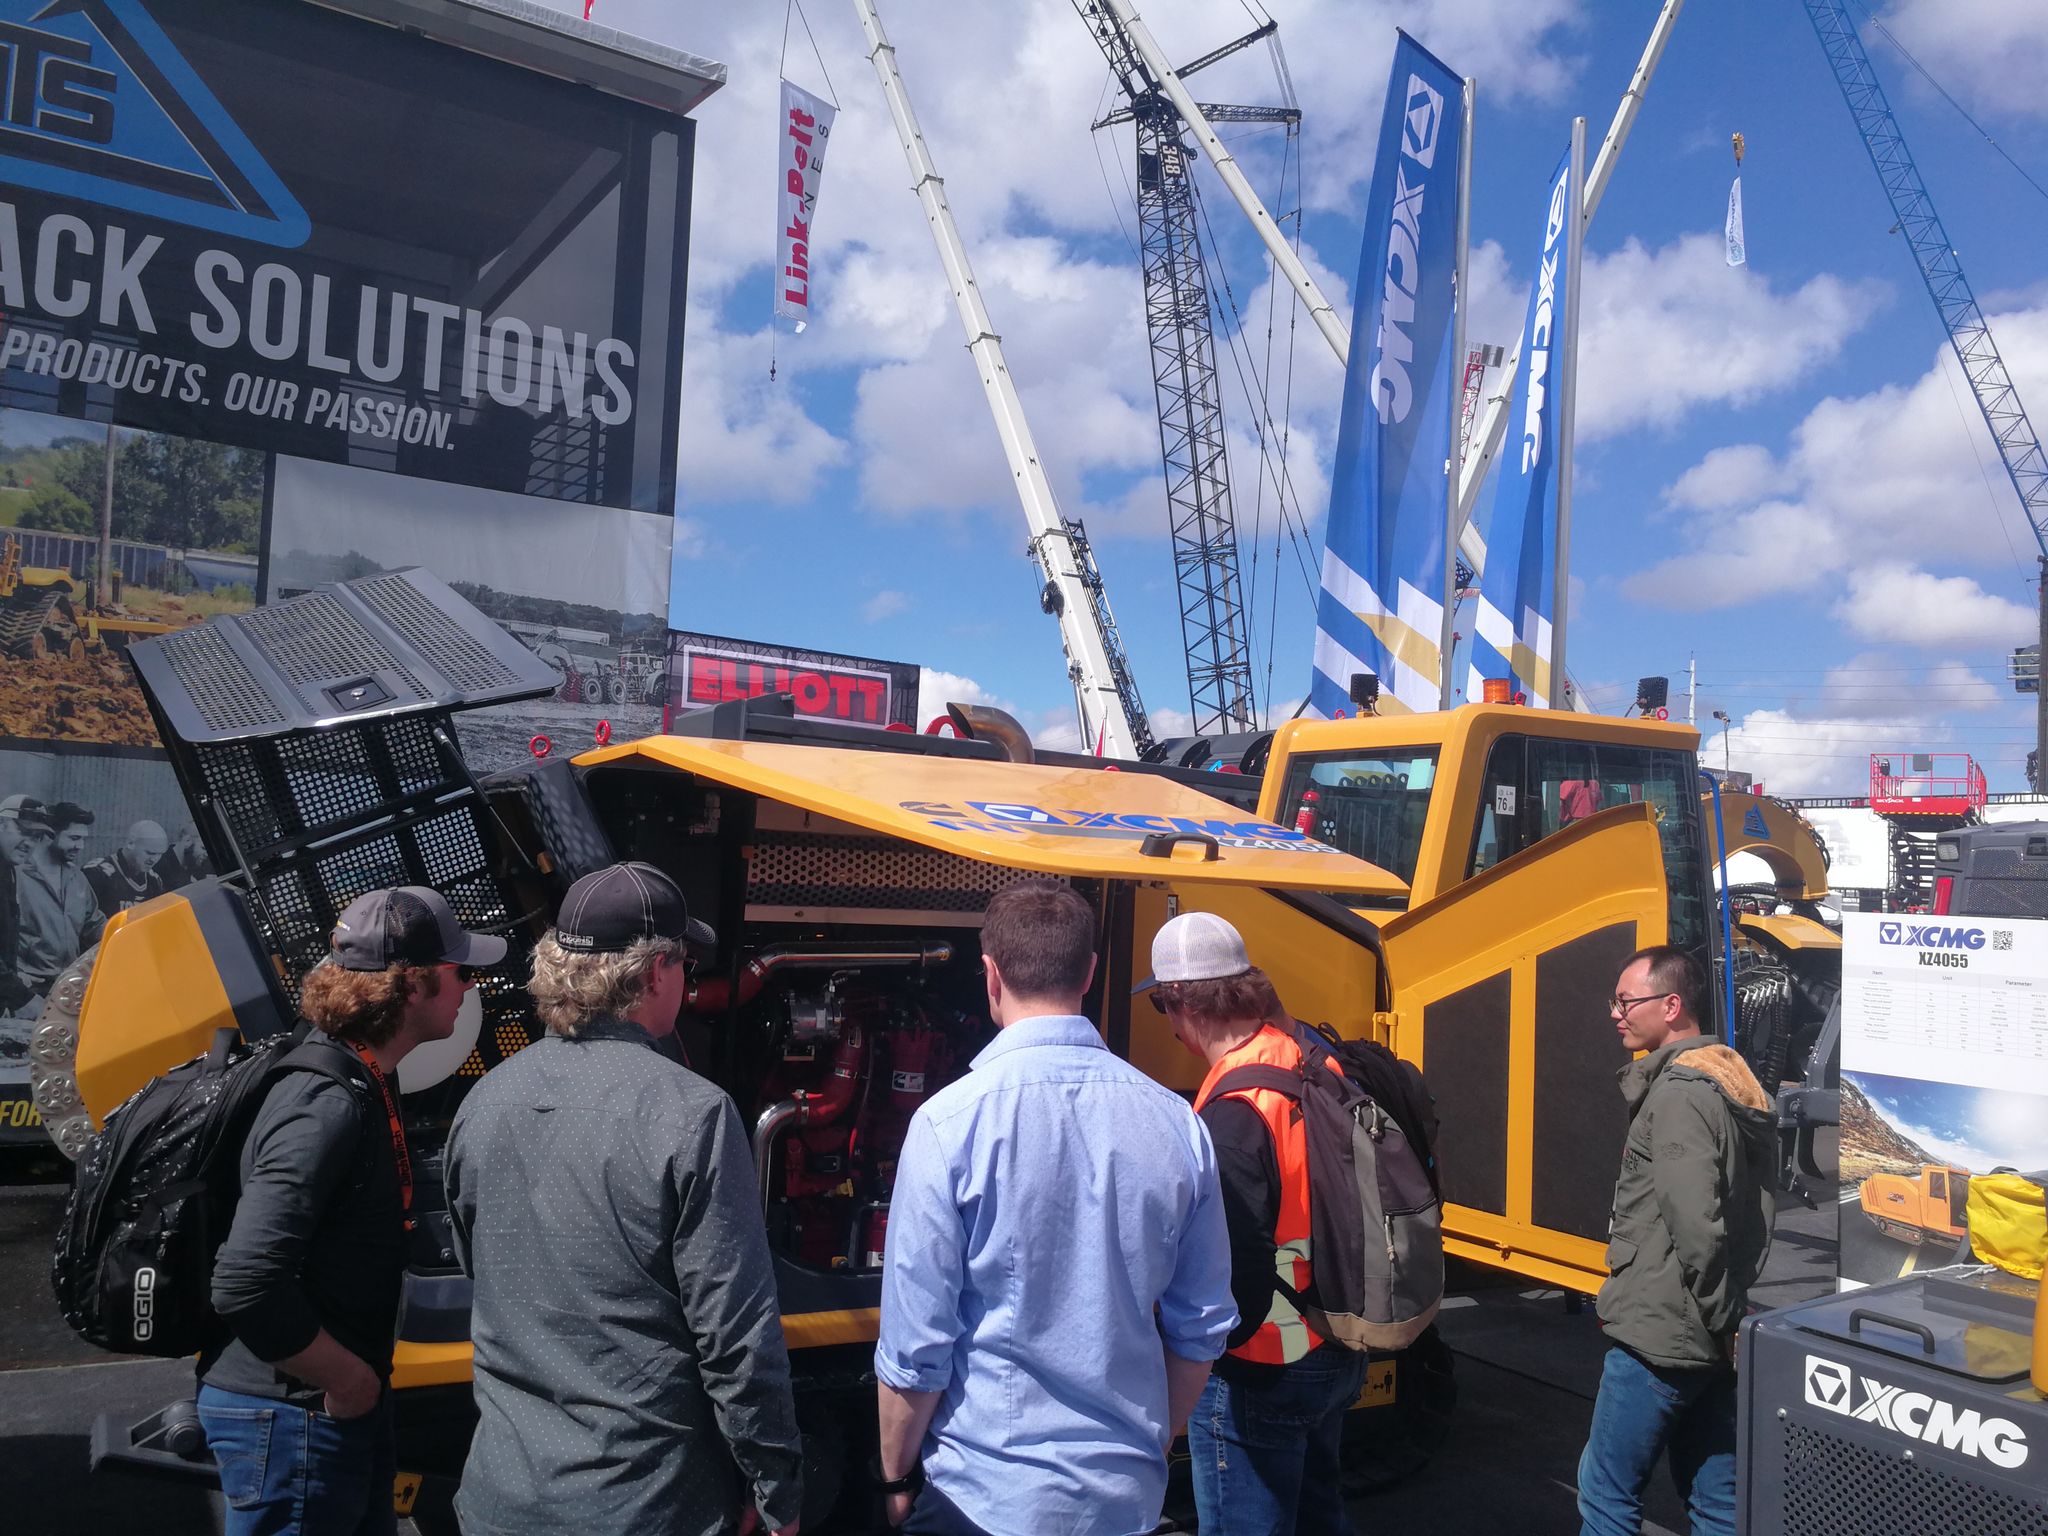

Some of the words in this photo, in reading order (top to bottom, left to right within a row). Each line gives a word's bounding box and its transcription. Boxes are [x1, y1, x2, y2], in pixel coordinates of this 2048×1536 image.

[0, 20, 117, 145] TS
[1162, 145, 1181, 174] 348
[1370, 160, 1425, 425] XCMG
[190, 248, 636, 426] SOLUTIONS
[1520, 246, 1560, 475] XCMG
[2, 328, 210, 406] PRODUCTS.
[225, 371, 300, 422] OUR
[304, 388, 455, 451] PASSION.
[692, 656, 886, 722] ELLIOTT
[1057, 808, 1307, 842] XCMG
[1497, 796, 1508, 811] 76
[1901, 924, 1987, 951] XCMG
[1918, 951, 1969, 969] XZ4055
[2005, 979, 2033, 987] Parameter
[134, 1267, 156, 1342] OGIO
[1849, 1375, 2029, 1469] XCMG
